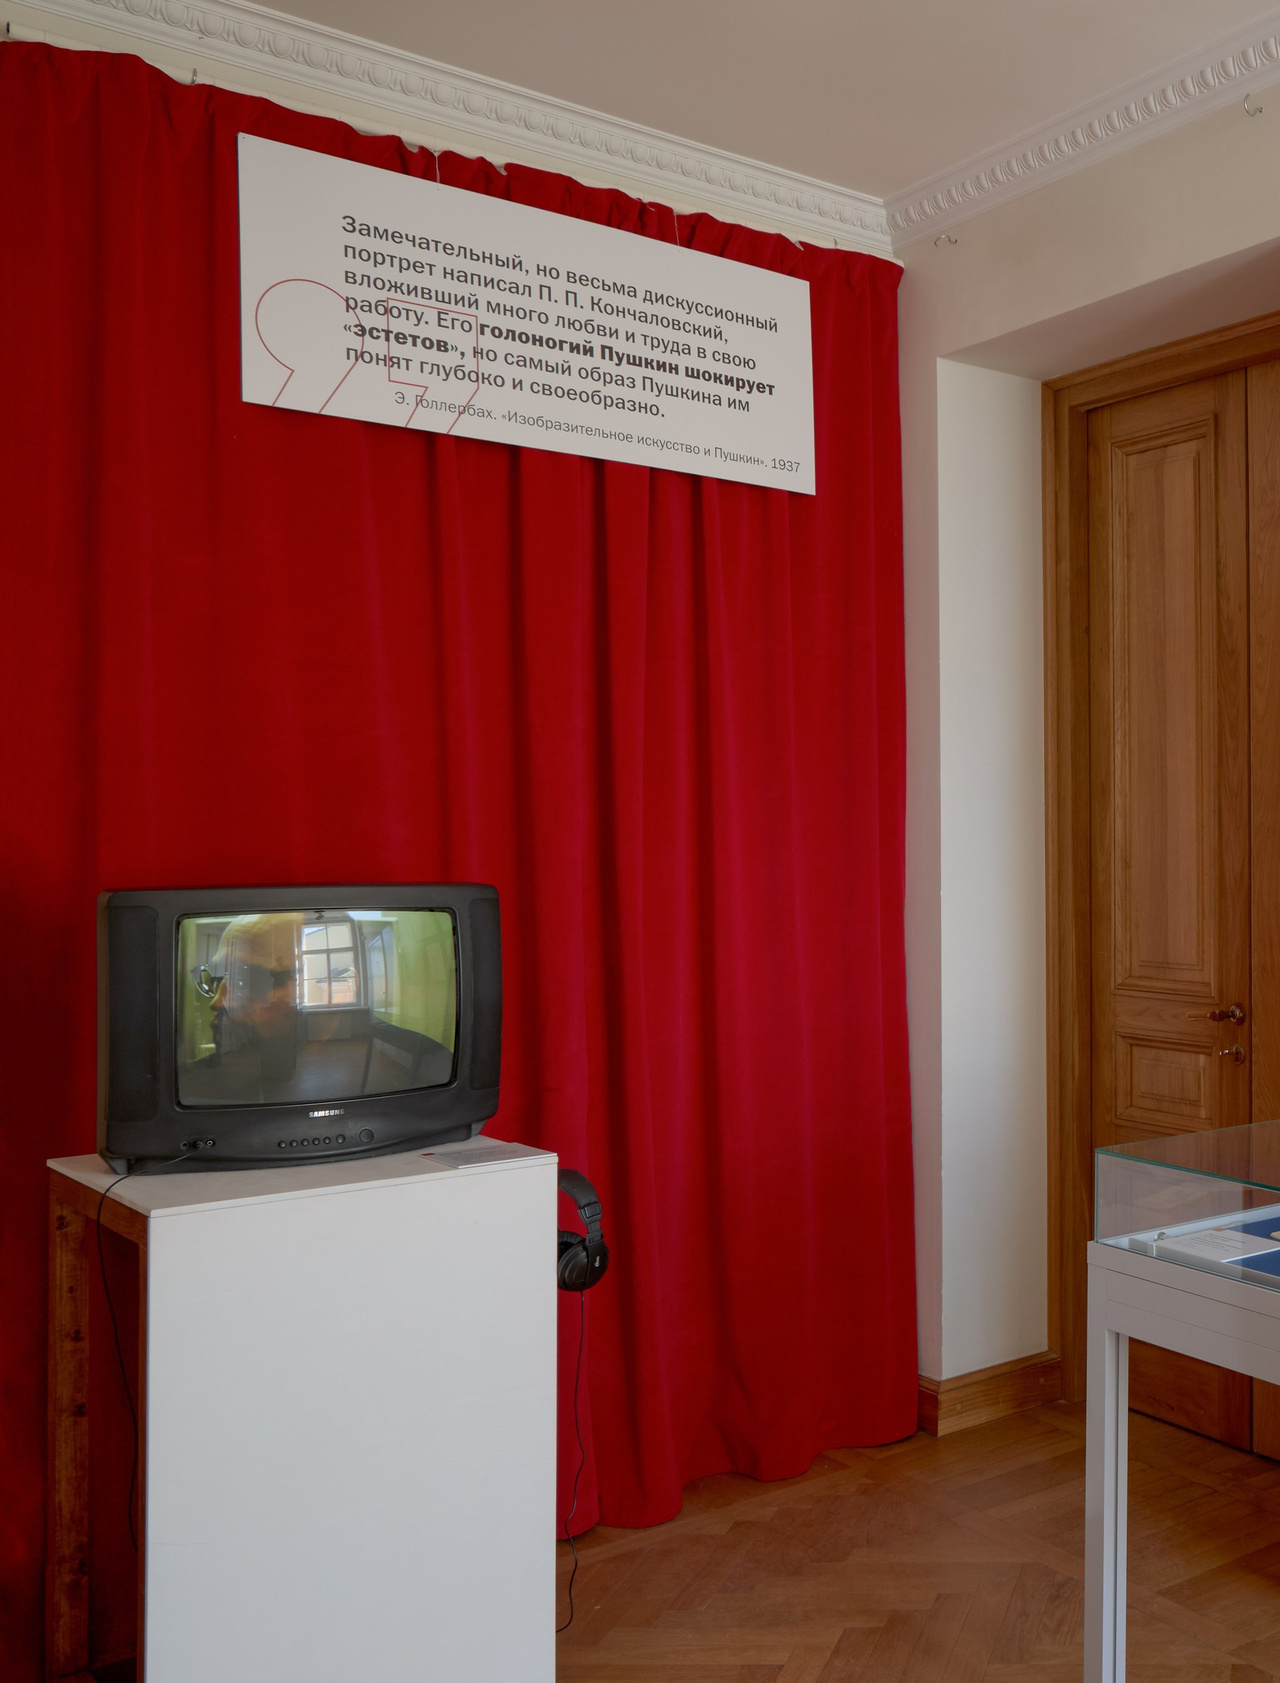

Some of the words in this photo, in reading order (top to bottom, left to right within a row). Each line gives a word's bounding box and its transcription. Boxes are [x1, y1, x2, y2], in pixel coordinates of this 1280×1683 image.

[342, 215, 529, 275] Замечательный,
[537, 263, 559, 280] но
[566, 270, 637, 298] весьма
[643, 290, 778, 332] дискуссионный
[344, 245, 436, 276] портрет
[443, 266, 532, 297] написал
[539, 284, 558, 304] П.
[565, 290, 584, 309] П.
[590, 295, 728, 344] Кончаловский,
[344, 270, 479, 310] вложивший
[487, 300, 548, 324] много
[555, 315, 619, 340] любви
[626, 330, 636, 343] и
[641, 333, 691, 356] труда
[697, 346, 706, 359] в
[712, 350, 756, 370] свою
[343, 323, 466, 360] «эстетов»,
[473, 346, 498, 362] но
[504, 352, 572, 376] самый
[578, 366, 636, 389] образ
[642, 376, 722, 406] Пушкина
[727, 398, 750, 412] им
[345, 296, 429, 326] работу.
[437, 311, 472, 333] Его
[479, 323, 594, 358] голоногий
[600, 344, 679, 376] Пушкин
[684, 365, 776, 395] шокирует
[346, 348, 412, 371] понят
[420, 360, 506, 388] глубоко
[512, 377, 524, 392] и
[530, 380, 665, 418] своеобразно.
[394, 391, 410, 406] Э.
[415, 394, 496, 420] Голлербах.
[502, 410, 634, 443] «Изобразительное
[637, 432, 700, 456] искусство
[704, 447, 711, 456] и
[714, 446, 768, 467] Пушкин».
[771, 458, 800, 472] 1937
[309, 1109, 344, 1118] SAMSUNG
